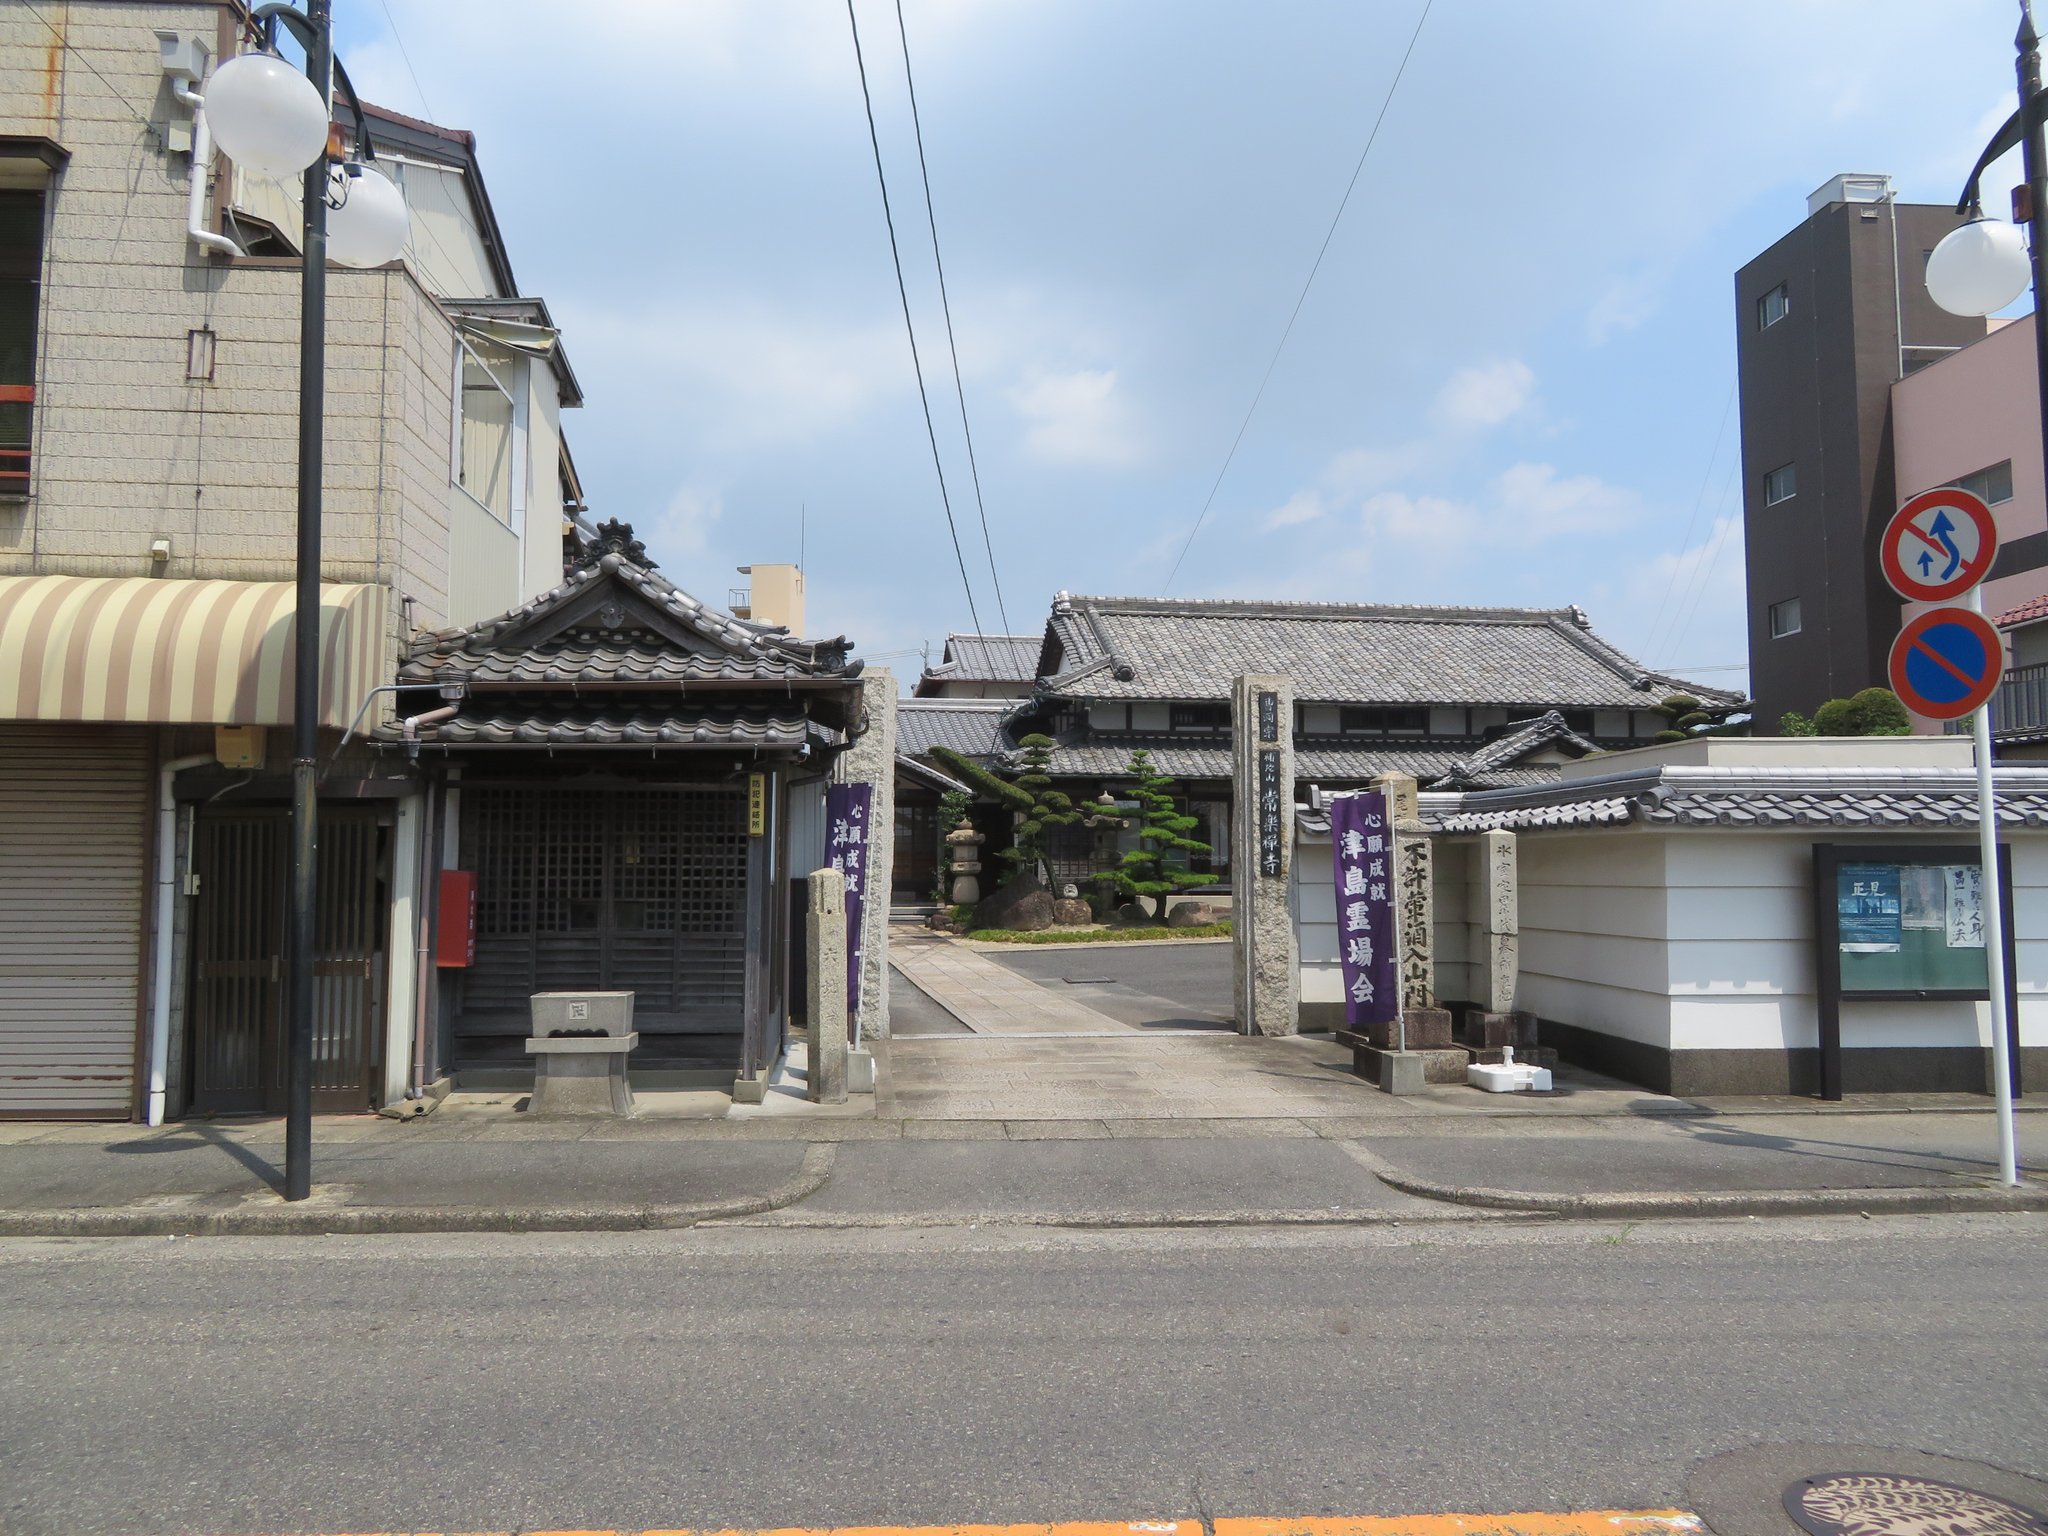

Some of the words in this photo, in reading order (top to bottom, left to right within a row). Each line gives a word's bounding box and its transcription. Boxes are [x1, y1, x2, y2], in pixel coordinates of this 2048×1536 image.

[1263, 695, 1275, 739] 曹洞宗
[751, 780, 761, 829] 防犯連絡所
[845, 803, 863, 892] 心願成就
[1364, 812, 1386, 901] 心願成就
[1340, 829, 1375, 1004] 津島霊場会
[1851, 881, 1887, 897] 正見
